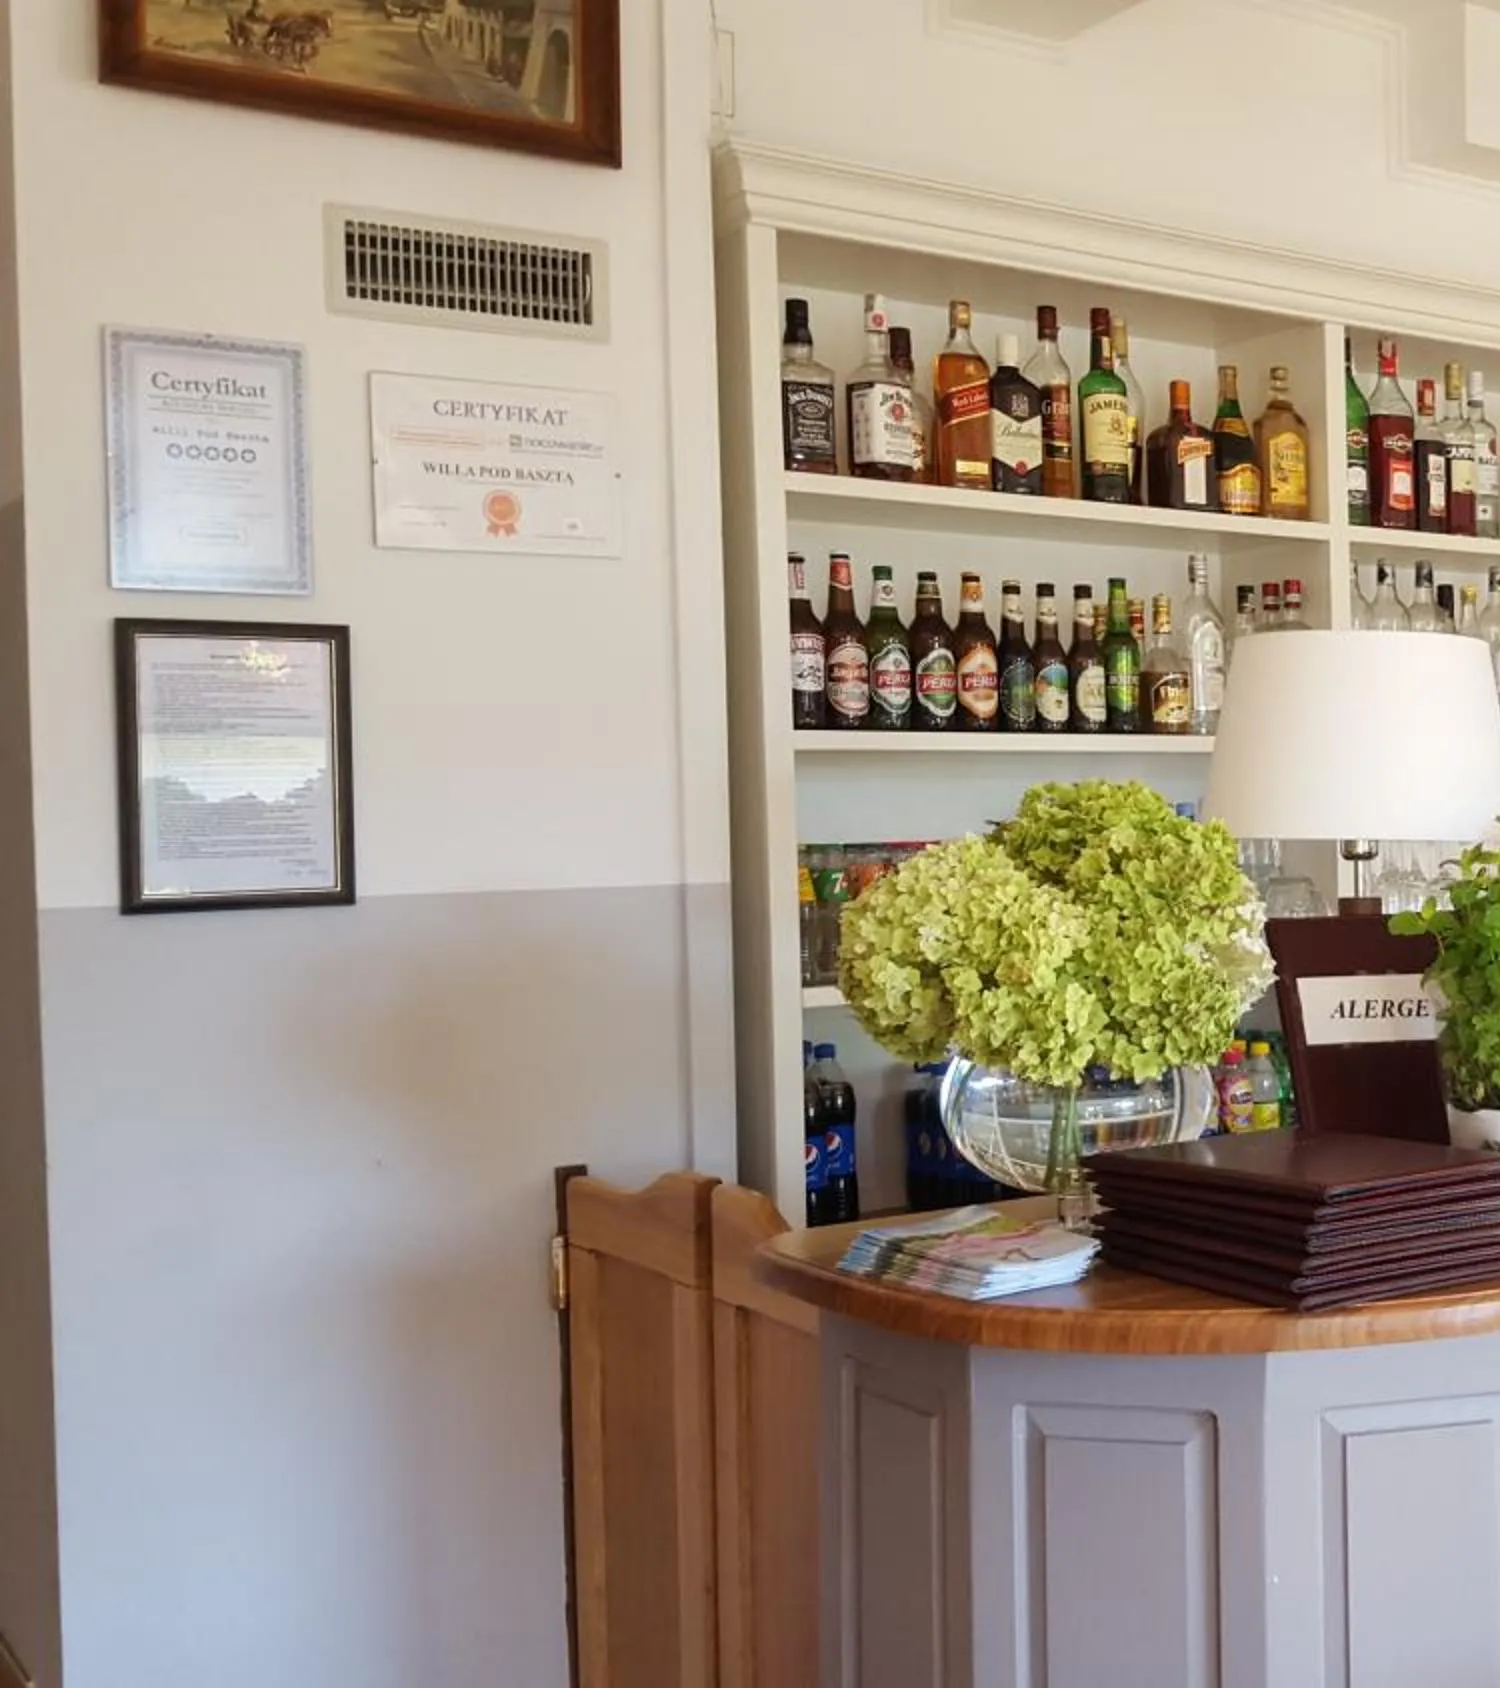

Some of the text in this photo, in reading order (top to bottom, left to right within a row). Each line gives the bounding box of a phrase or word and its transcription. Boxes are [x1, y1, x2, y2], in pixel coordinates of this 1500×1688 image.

[150, 371, 266, 400] Certyfikat
[432, 399, 568, 427] CERTYFIKAT
[422, 461, 476, 478] WILLA
[479, 465, 512, 480] POD
[1330, 998, 1430, 1019] ALERGE
